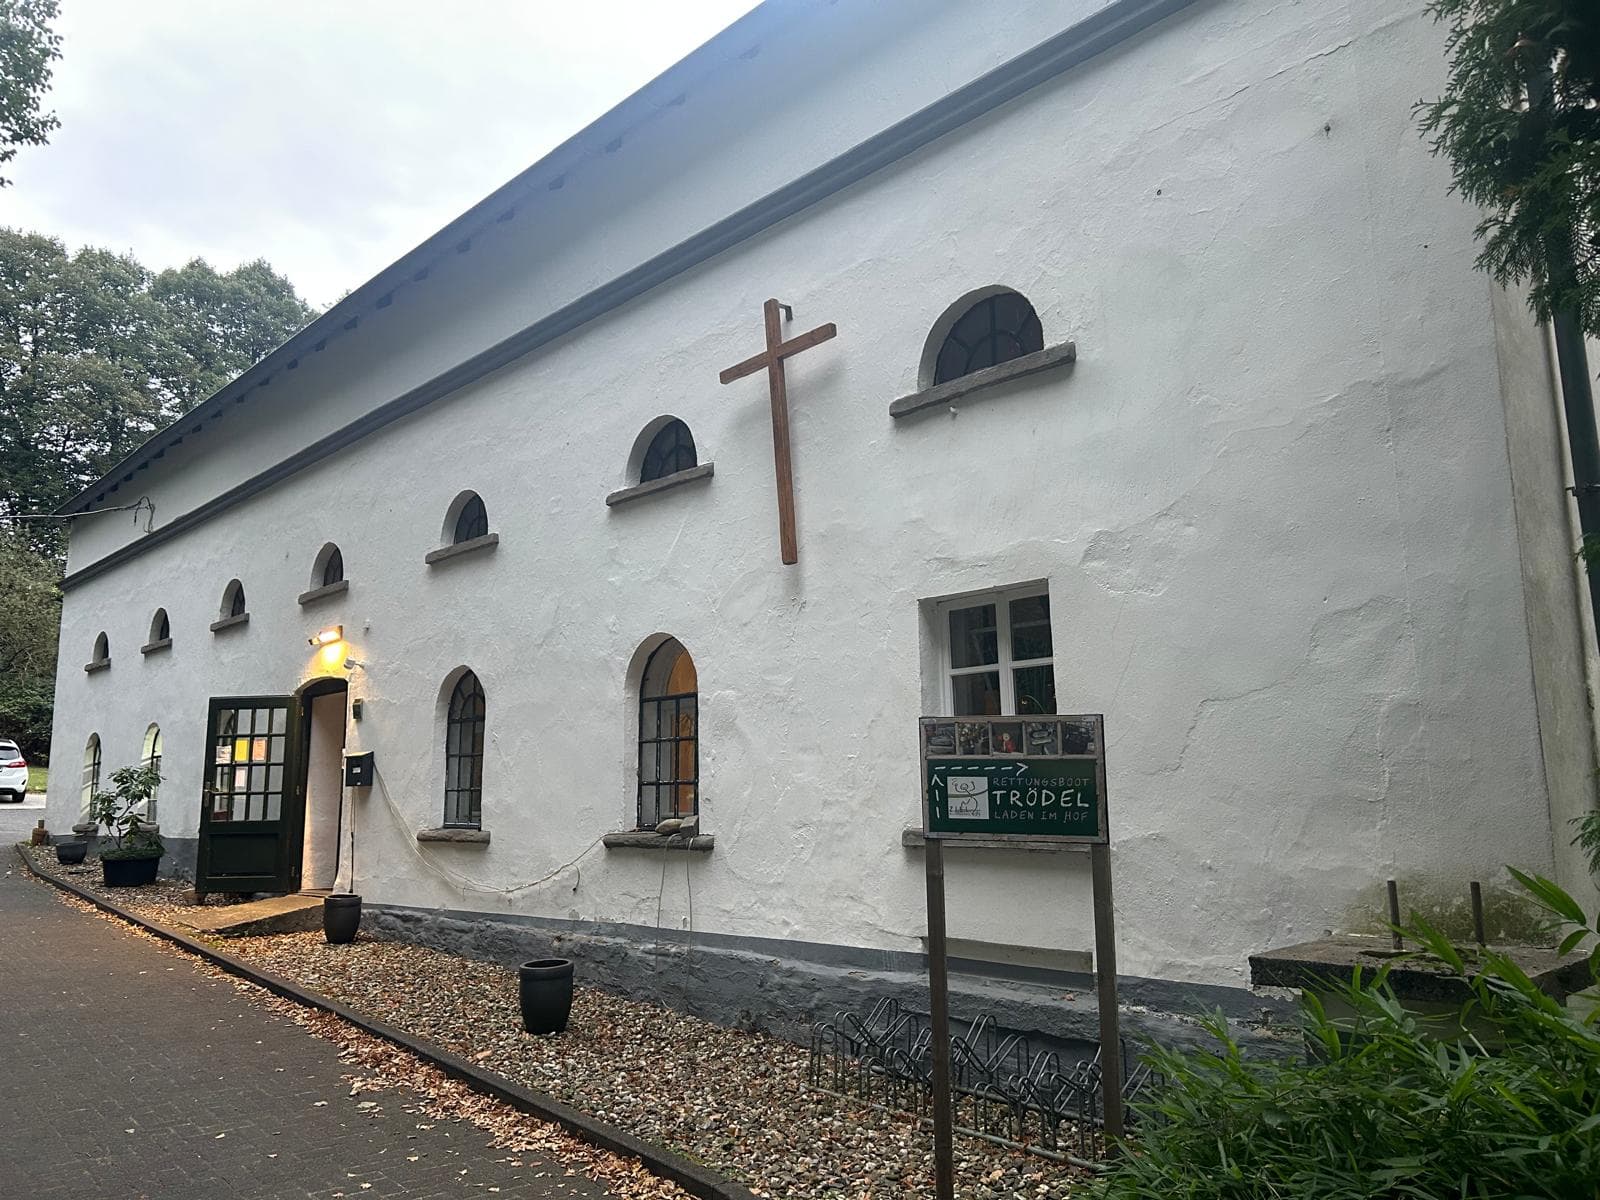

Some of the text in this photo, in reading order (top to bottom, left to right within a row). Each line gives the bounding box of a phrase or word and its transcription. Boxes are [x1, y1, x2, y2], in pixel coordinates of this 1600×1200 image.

[992, 776, 1090, 787] RETTUNGSBOOT
[992, 788, 1089, 807] TRÖDEL
[994, 810, 1088, 823] LADEN IM HOF
